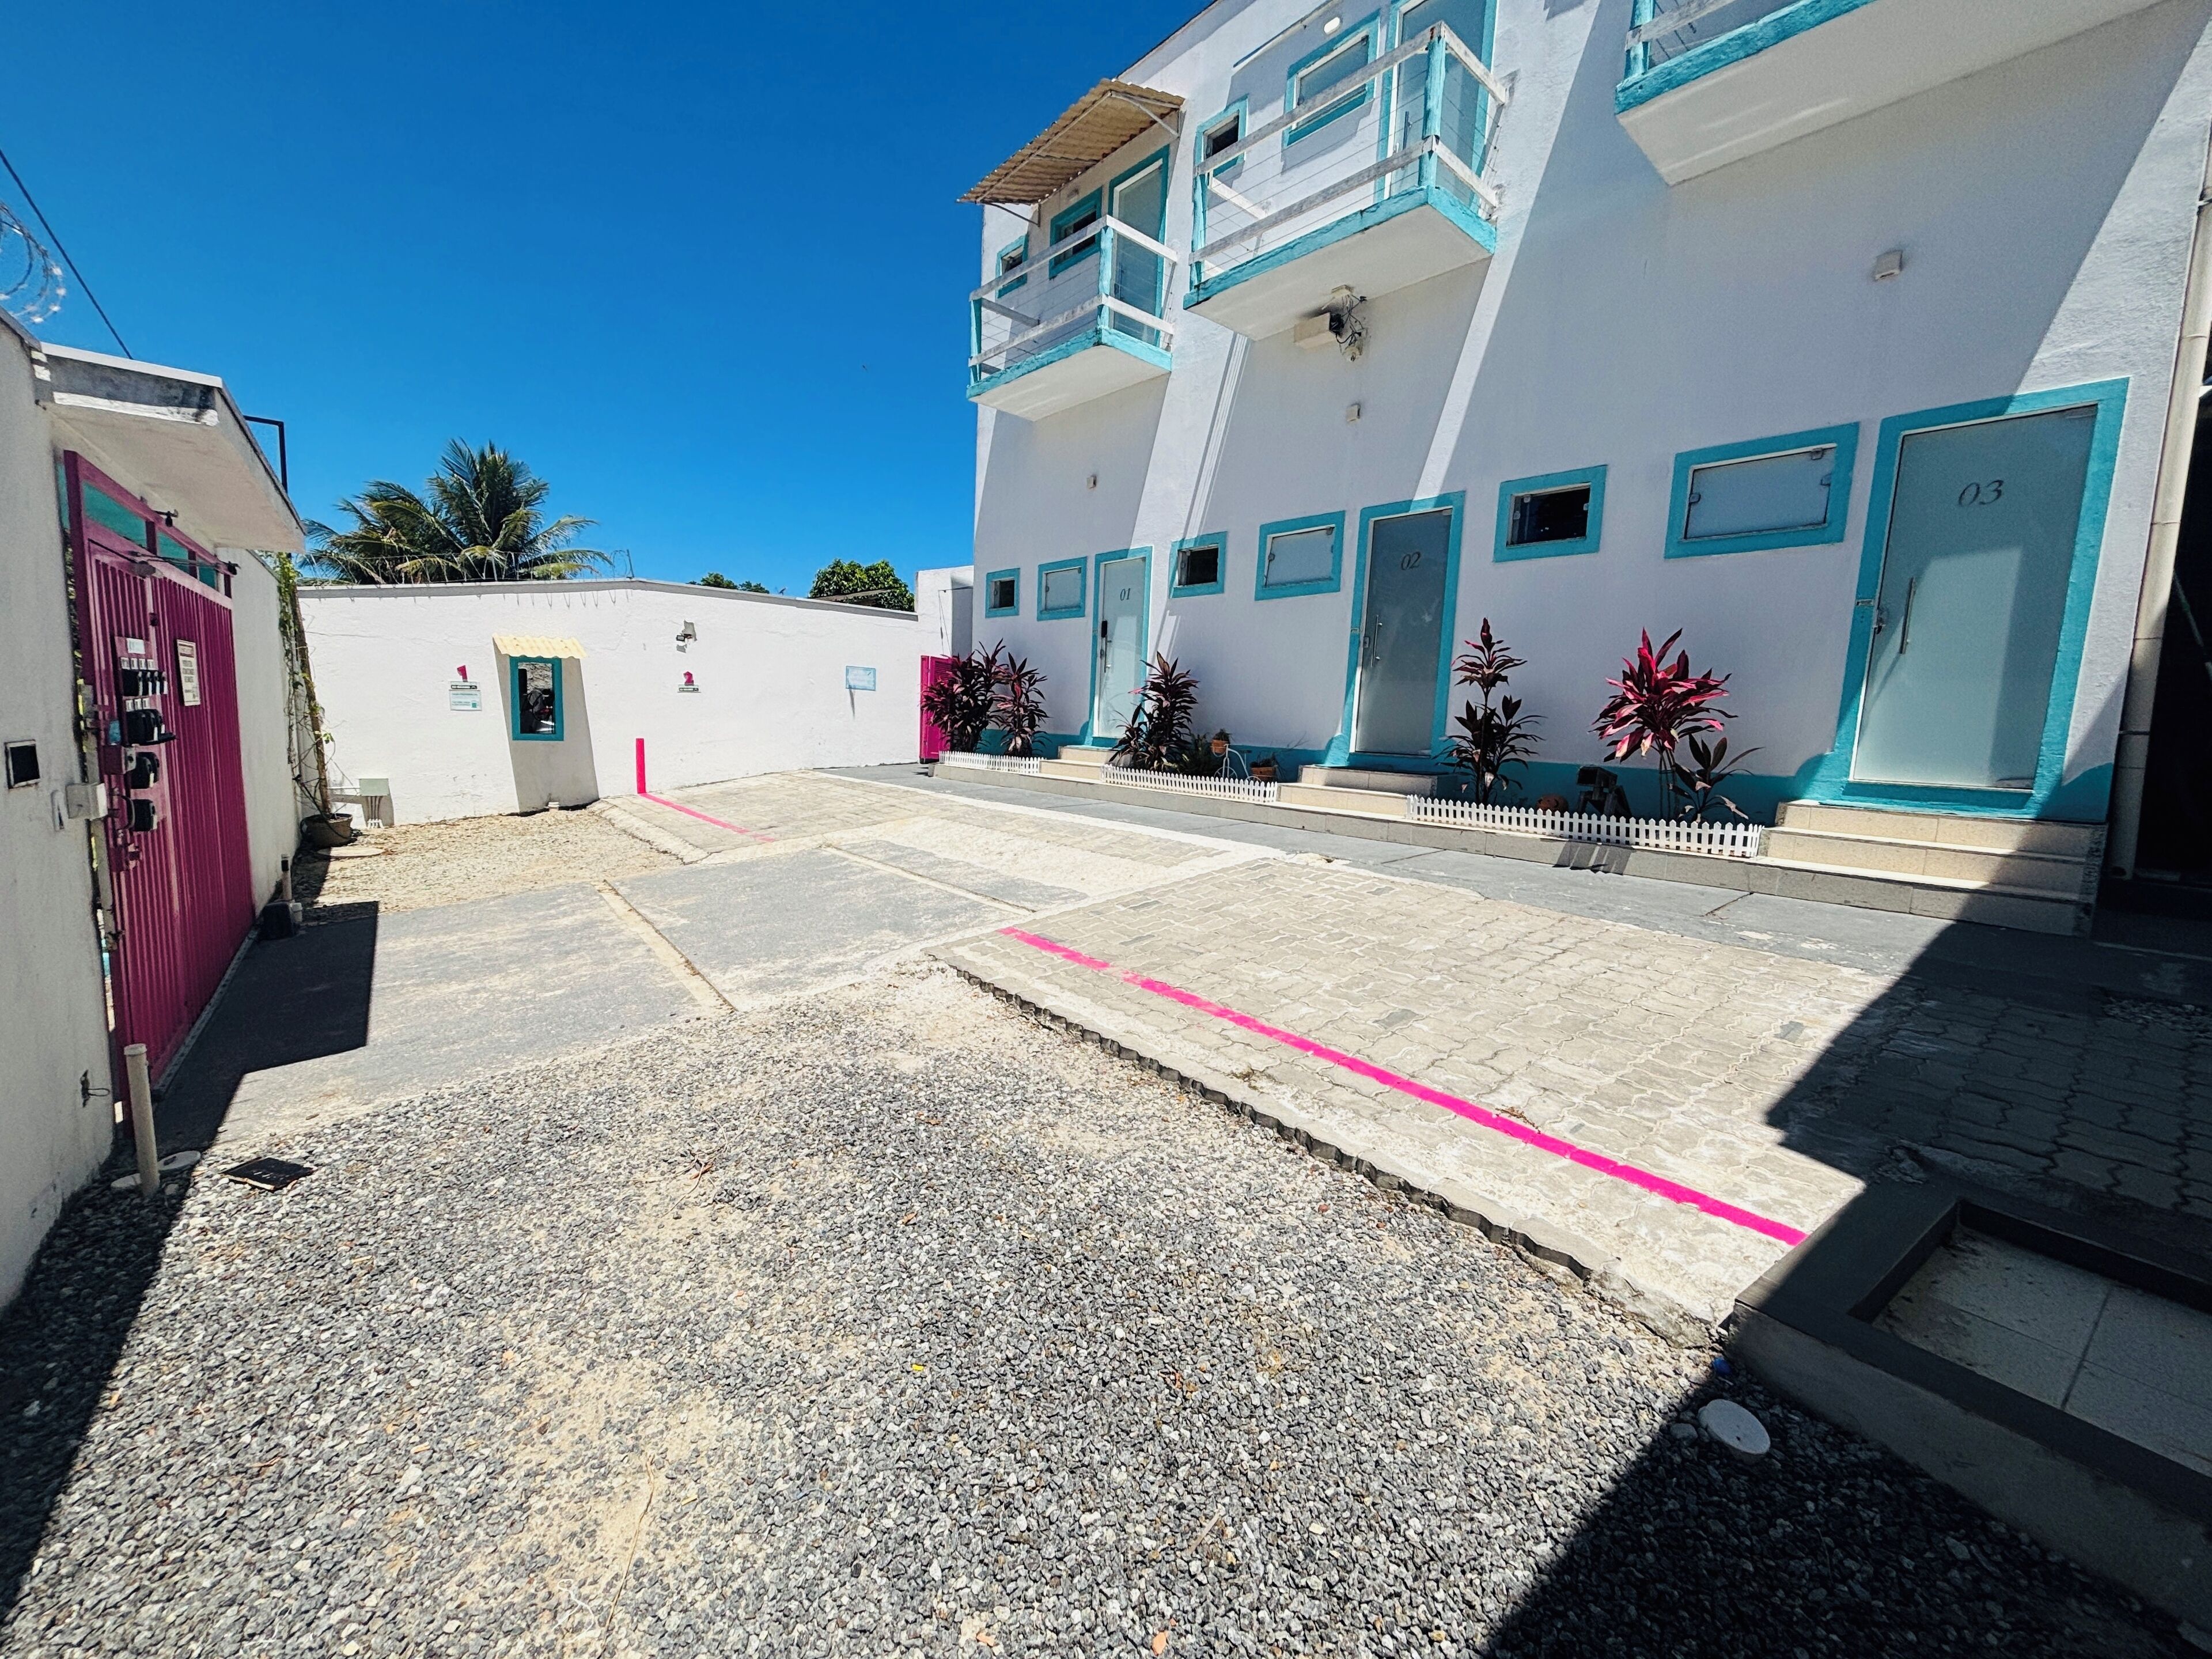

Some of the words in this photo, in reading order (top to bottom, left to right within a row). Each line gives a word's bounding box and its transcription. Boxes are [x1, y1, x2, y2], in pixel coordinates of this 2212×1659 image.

[1958, 479, 2004, 506] 03
[1401, 551, 1421, 570] 02
[1120, 588, 1130, 601] 01
[457, 665, 468, 682] 1
[683, 671, 694, 686] 2
